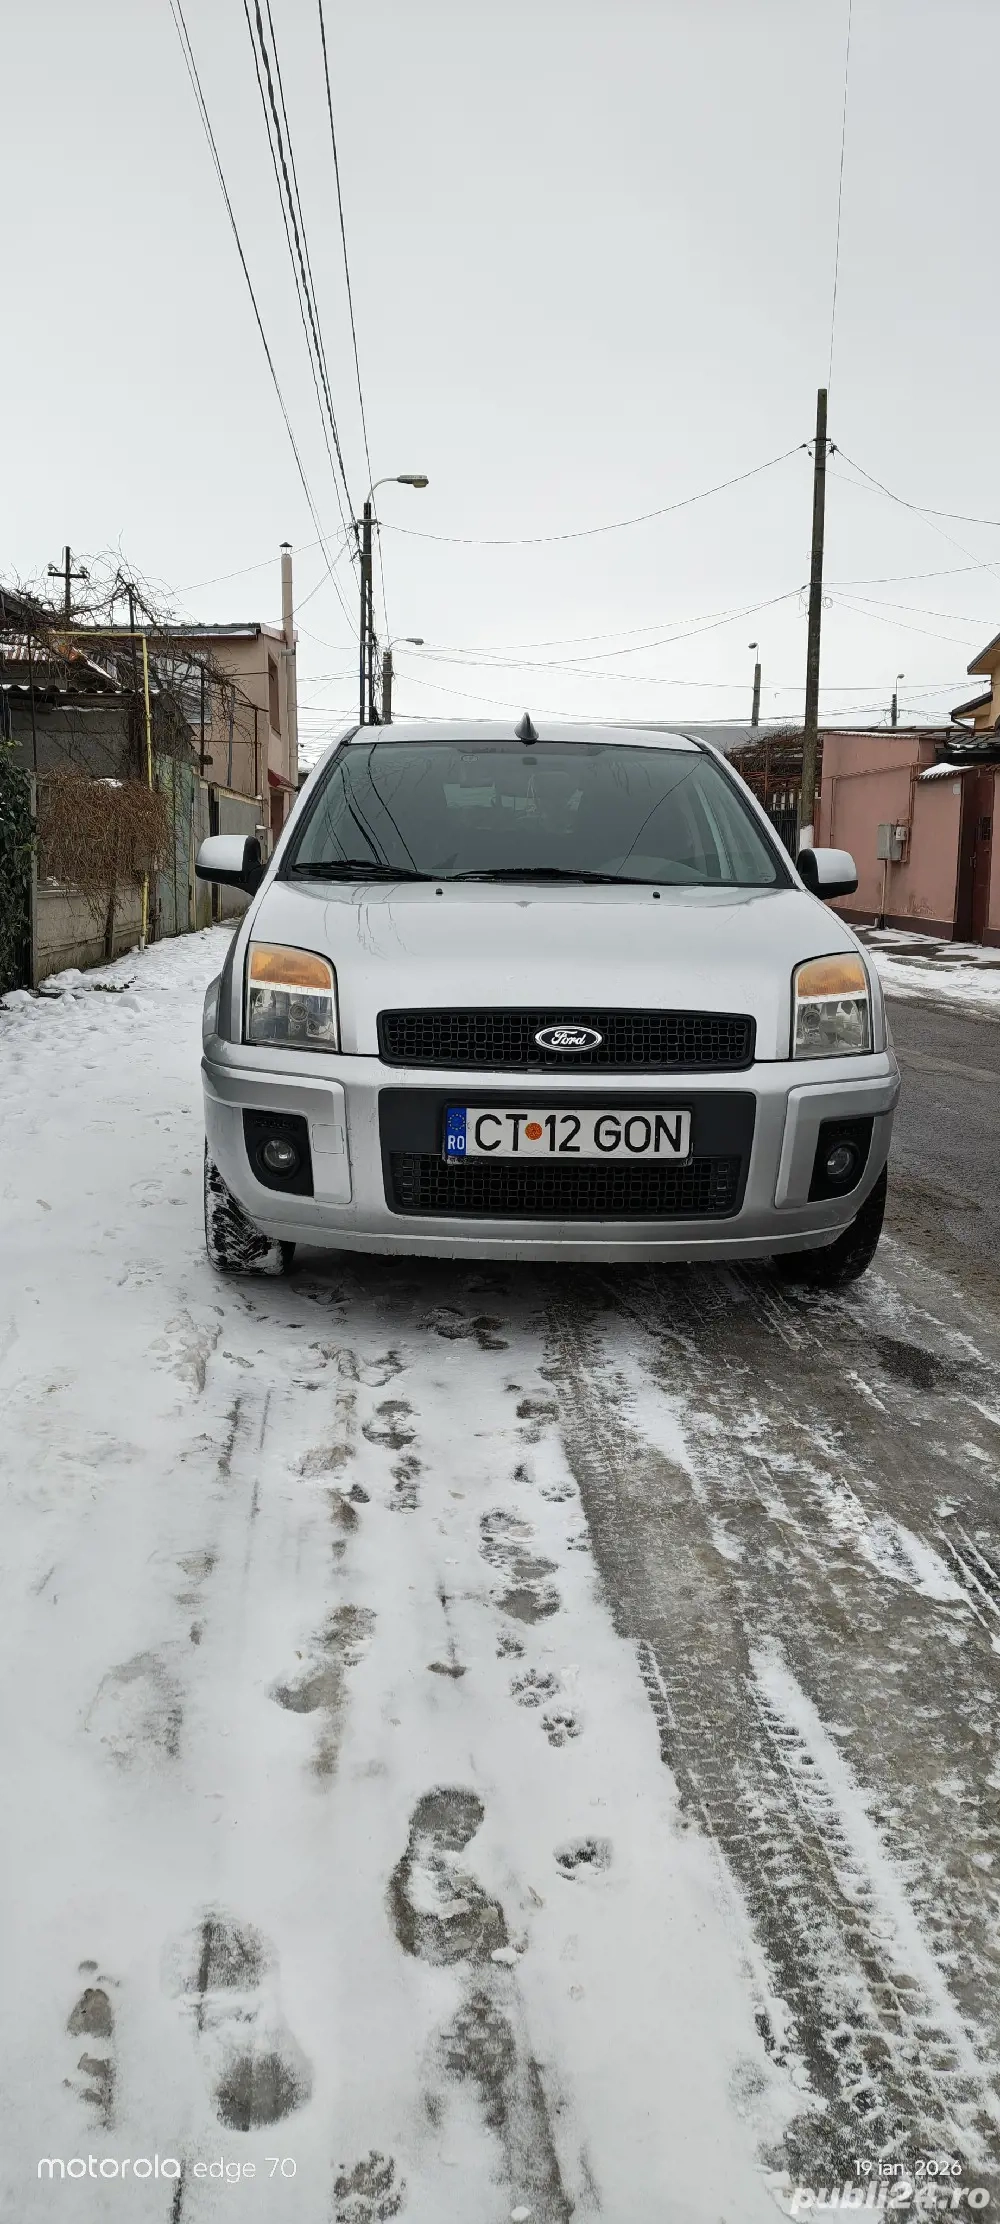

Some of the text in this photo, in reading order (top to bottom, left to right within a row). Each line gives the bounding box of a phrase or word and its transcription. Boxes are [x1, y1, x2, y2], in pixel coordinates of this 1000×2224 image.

[551, 1030, 587, 1045] Ford
[474, 1113, 682, 1153] CT 12 GON
[447, 1136, 464, 1150] RO
